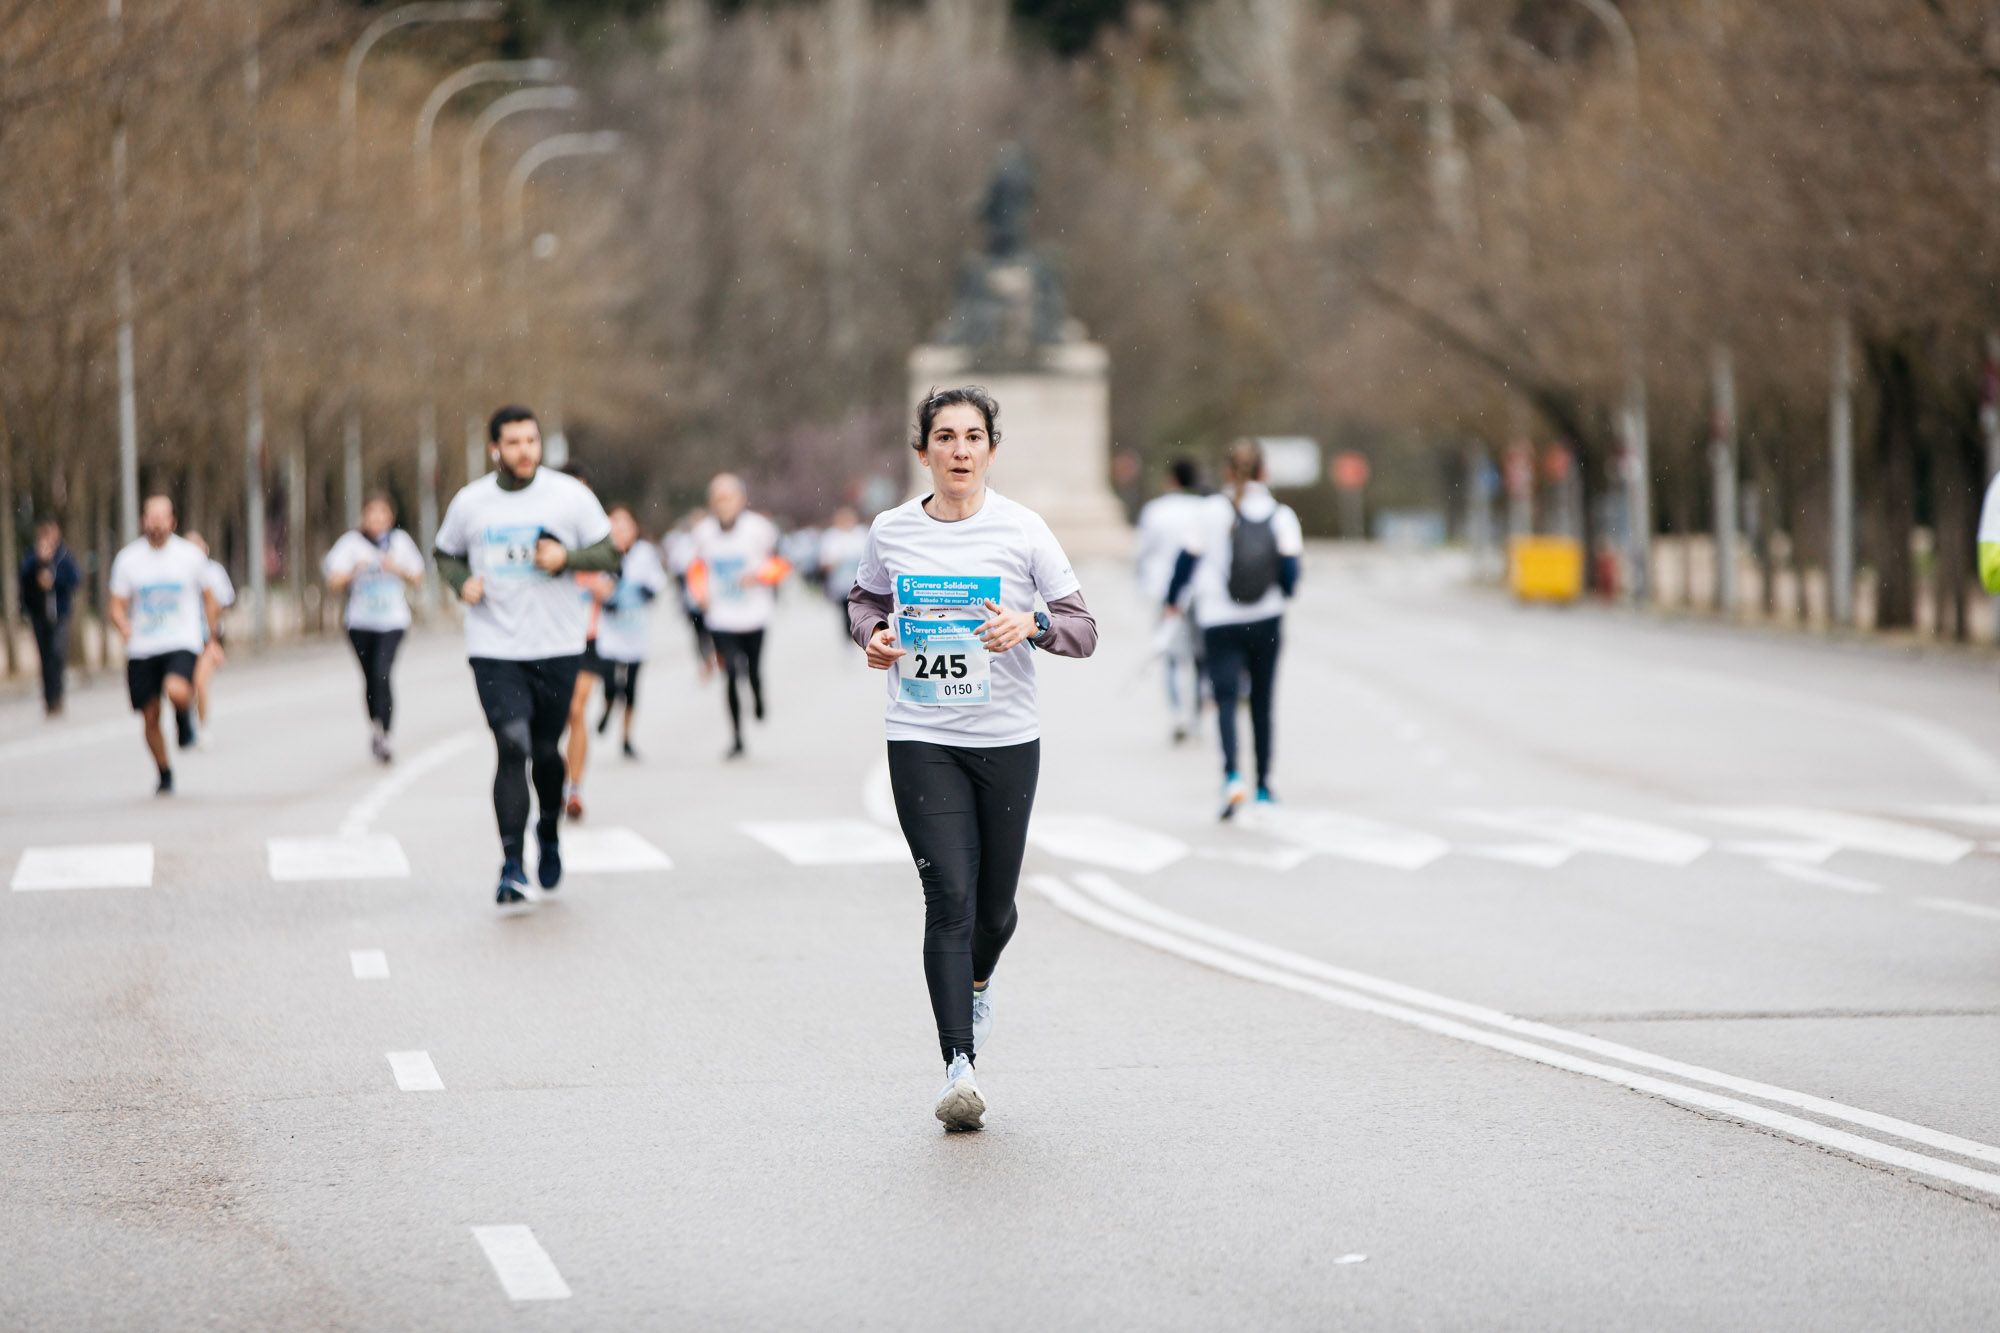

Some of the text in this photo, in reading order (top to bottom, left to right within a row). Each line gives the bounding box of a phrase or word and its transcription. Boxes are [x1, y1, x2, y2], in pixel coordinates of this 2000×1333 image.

[912, 581, 941, 590] Carrera
[943, 581, 978, 590] Solidaria
[911, 626, 936, 634] Carrera
[938, 626, 971, 634] Solidaria
[915, 654, 968, 679] 245
[944, 683, 972, 696] 0150
